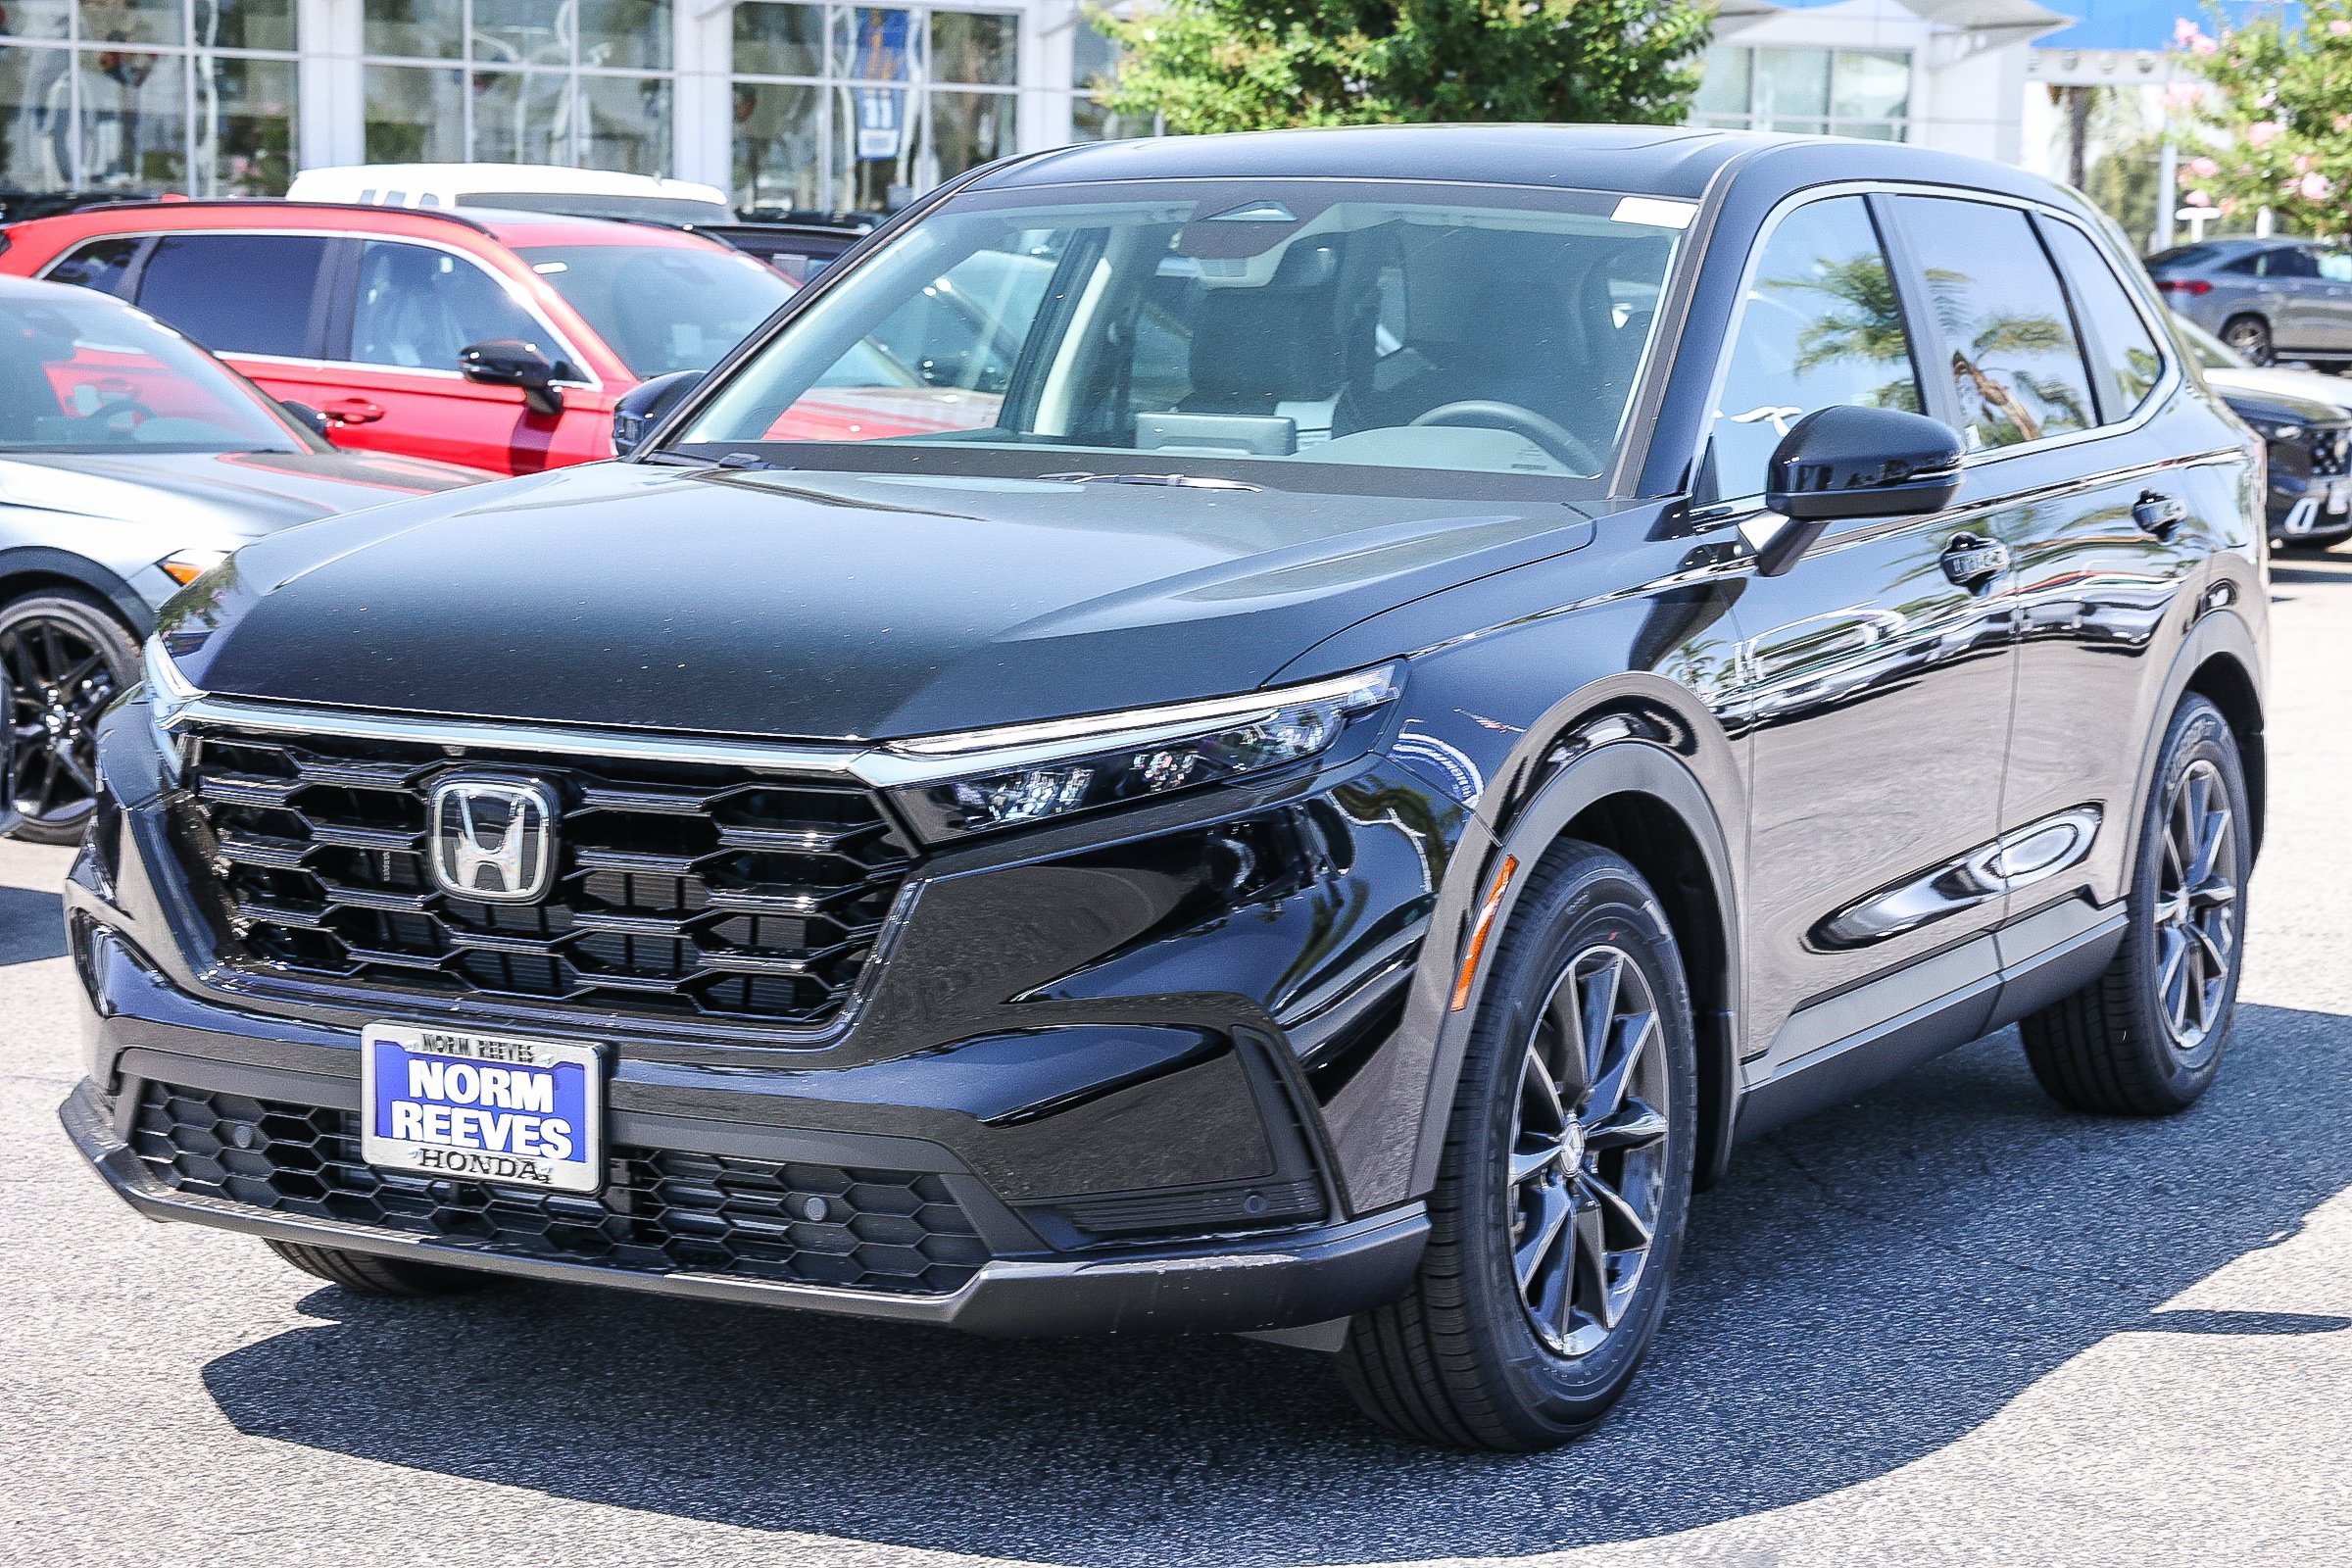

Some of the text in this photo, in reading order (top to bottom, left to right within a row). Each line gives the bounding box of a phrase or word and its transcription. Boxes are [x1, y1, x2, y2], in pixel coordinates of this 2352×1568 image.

[421, 1033, 535, 1062] NORM REEVES
[408, 1058, 554, 1114] NORM
[391, 1100, 573, 1160] REEVES
[419, 1149, 541, 1181] HONDA
